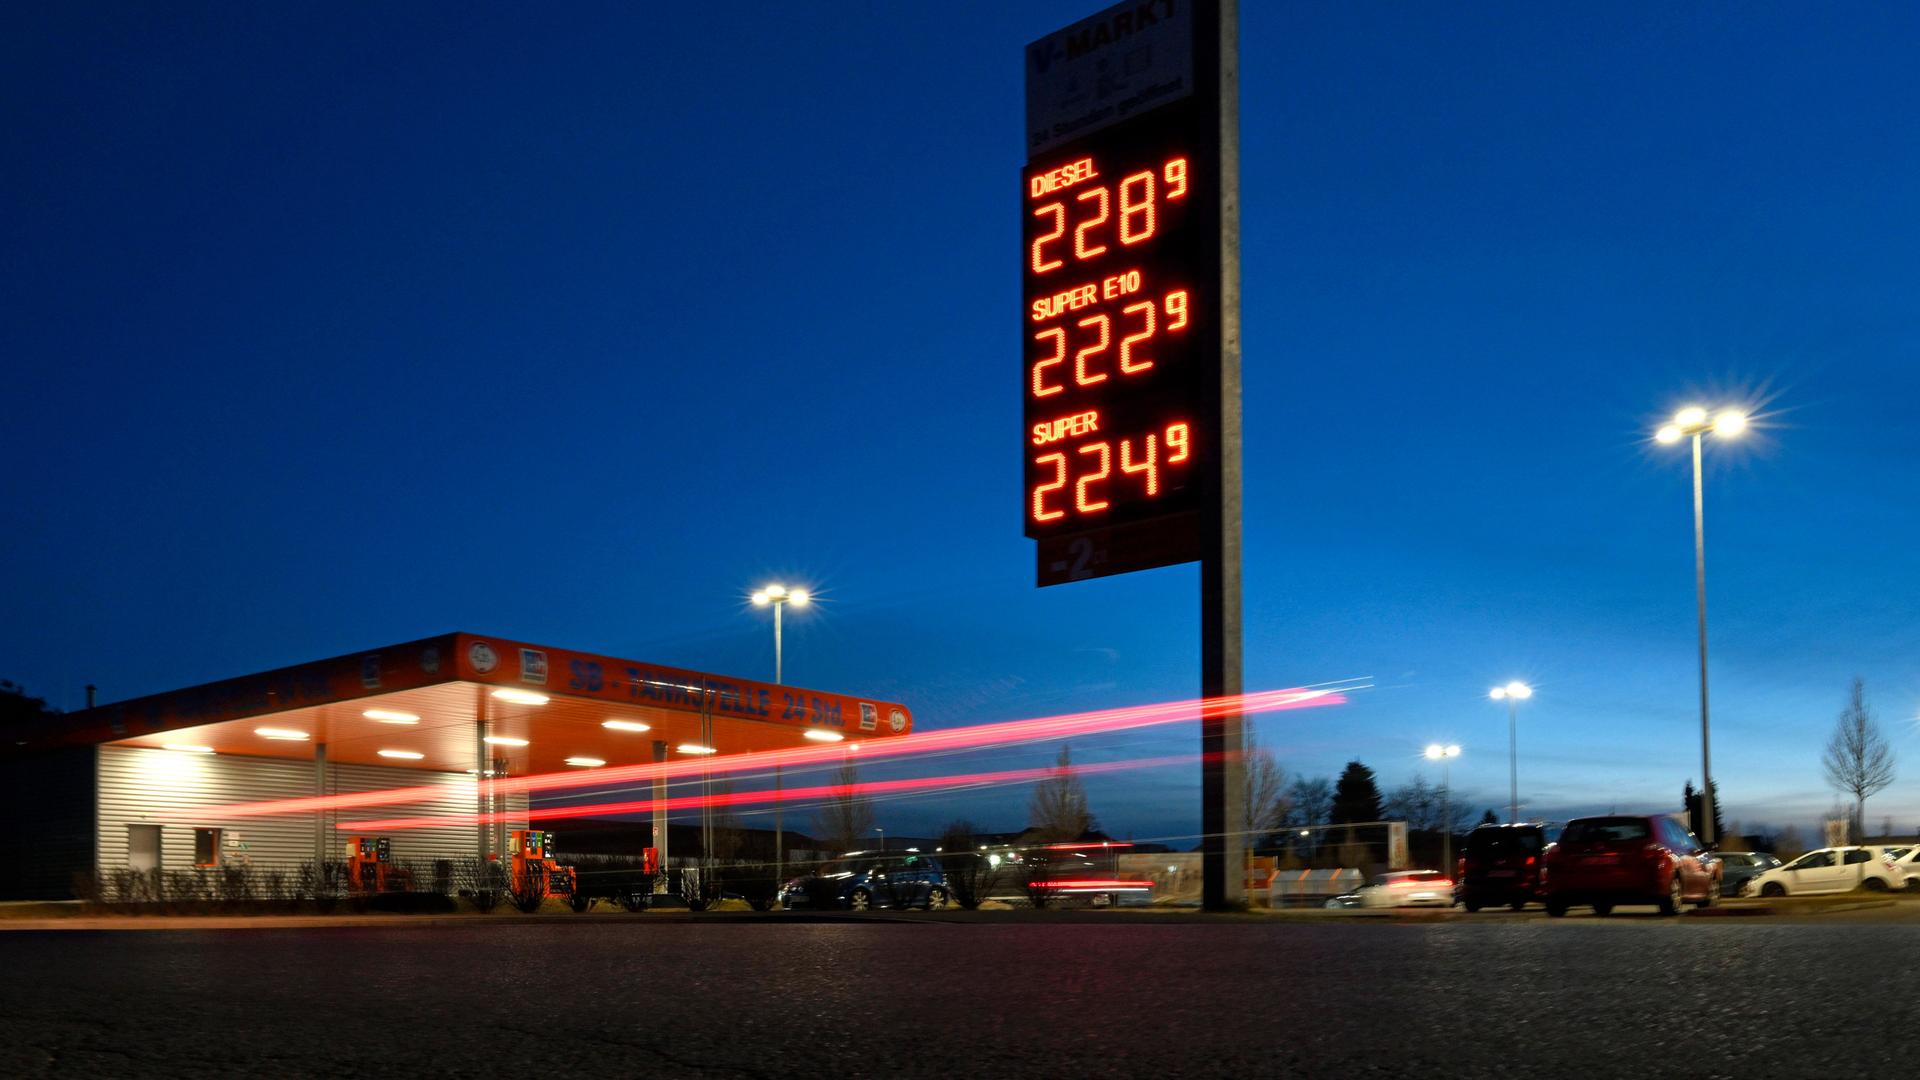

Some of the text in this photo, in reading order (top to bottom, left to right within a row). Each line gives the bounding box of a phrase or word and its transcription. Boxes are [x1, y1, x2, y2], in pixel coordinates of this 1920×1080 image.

[1031, 158, 1098, 198] DIESEL
[1032, 270, 1141, 321] SUPER E10
[1033, 411, 1099, 445] SUPER
